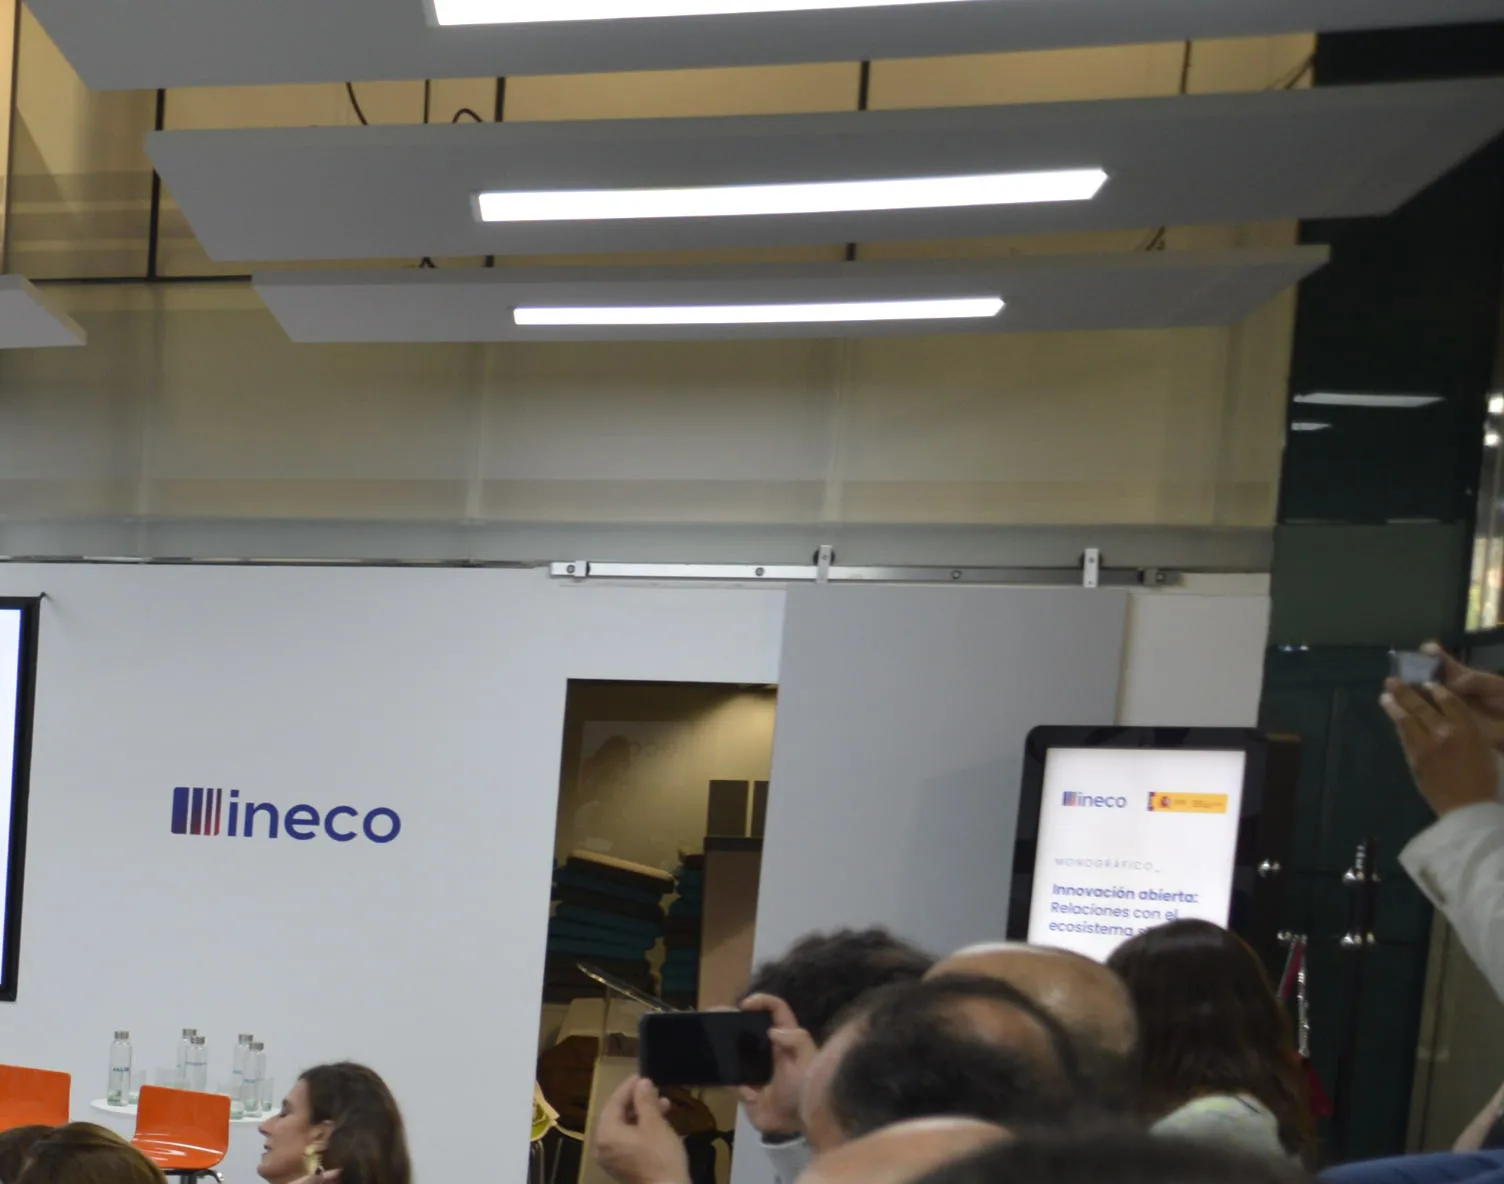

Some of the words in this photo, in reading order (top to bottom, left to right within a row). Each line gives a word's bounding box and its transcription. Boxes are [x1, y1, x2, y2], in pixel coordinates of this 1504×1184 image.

[1078, 792, 1128, 809] ineco
[227, 789, 401, 843] ineco
[1052, 883, 1135, 901] Innovación
[1138, 887, 1200, 904] abierta:
[1050, 901, 1130, 918] Relaciones
[1133, 908, 1161, 920] con
[1165, 908, 1179, 921] el
[1048, 920, 1134, 937] ecosistema
